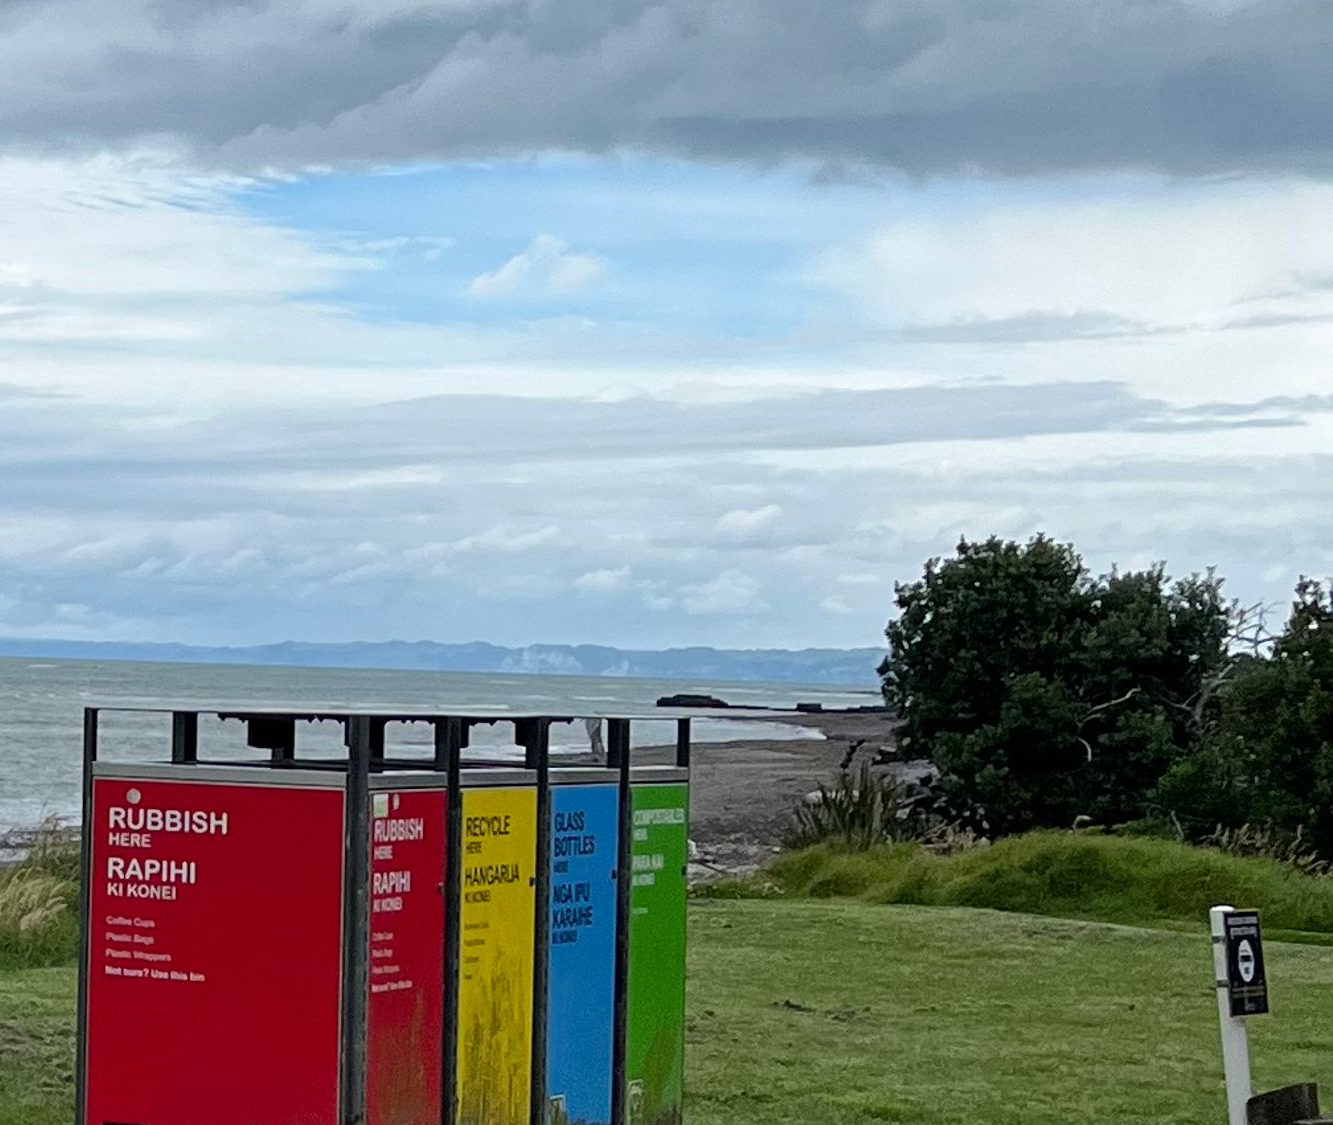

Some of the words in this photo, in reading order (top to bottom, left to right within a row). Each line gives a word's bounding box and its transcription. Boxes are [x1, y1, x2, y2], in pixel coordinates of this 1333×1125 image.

[108, 806, 228, 835] RUBBISH
[374, 817, 424, 842] RUBBISH
[466, 815, 510, 837] RECYCLE
[555, 811, 585, 831] GLASS
[108, 832, 152, 848] HERE
[555, 835, 594, 856] BOTTLES
[373, 845, 393, 860] HERE
[107, 857, 196, 885] RAPIHI
[107, 882, 123, 897] KI
[126, 884, 177, 900] KONEI
[373, 870, 411, 895] RAPIHI
[106, 916, 132, 926] Coffee
[133, 917, 155, 928] Cups
[106, 932, 132, 942] Plastic
[105, 965, 122, 976] Not
[123, 968, 149, 977] sure?
[150, 969, 169, 979] Use
[170, 971, 188, 980] this
[189, 972, 205, 982] bin
